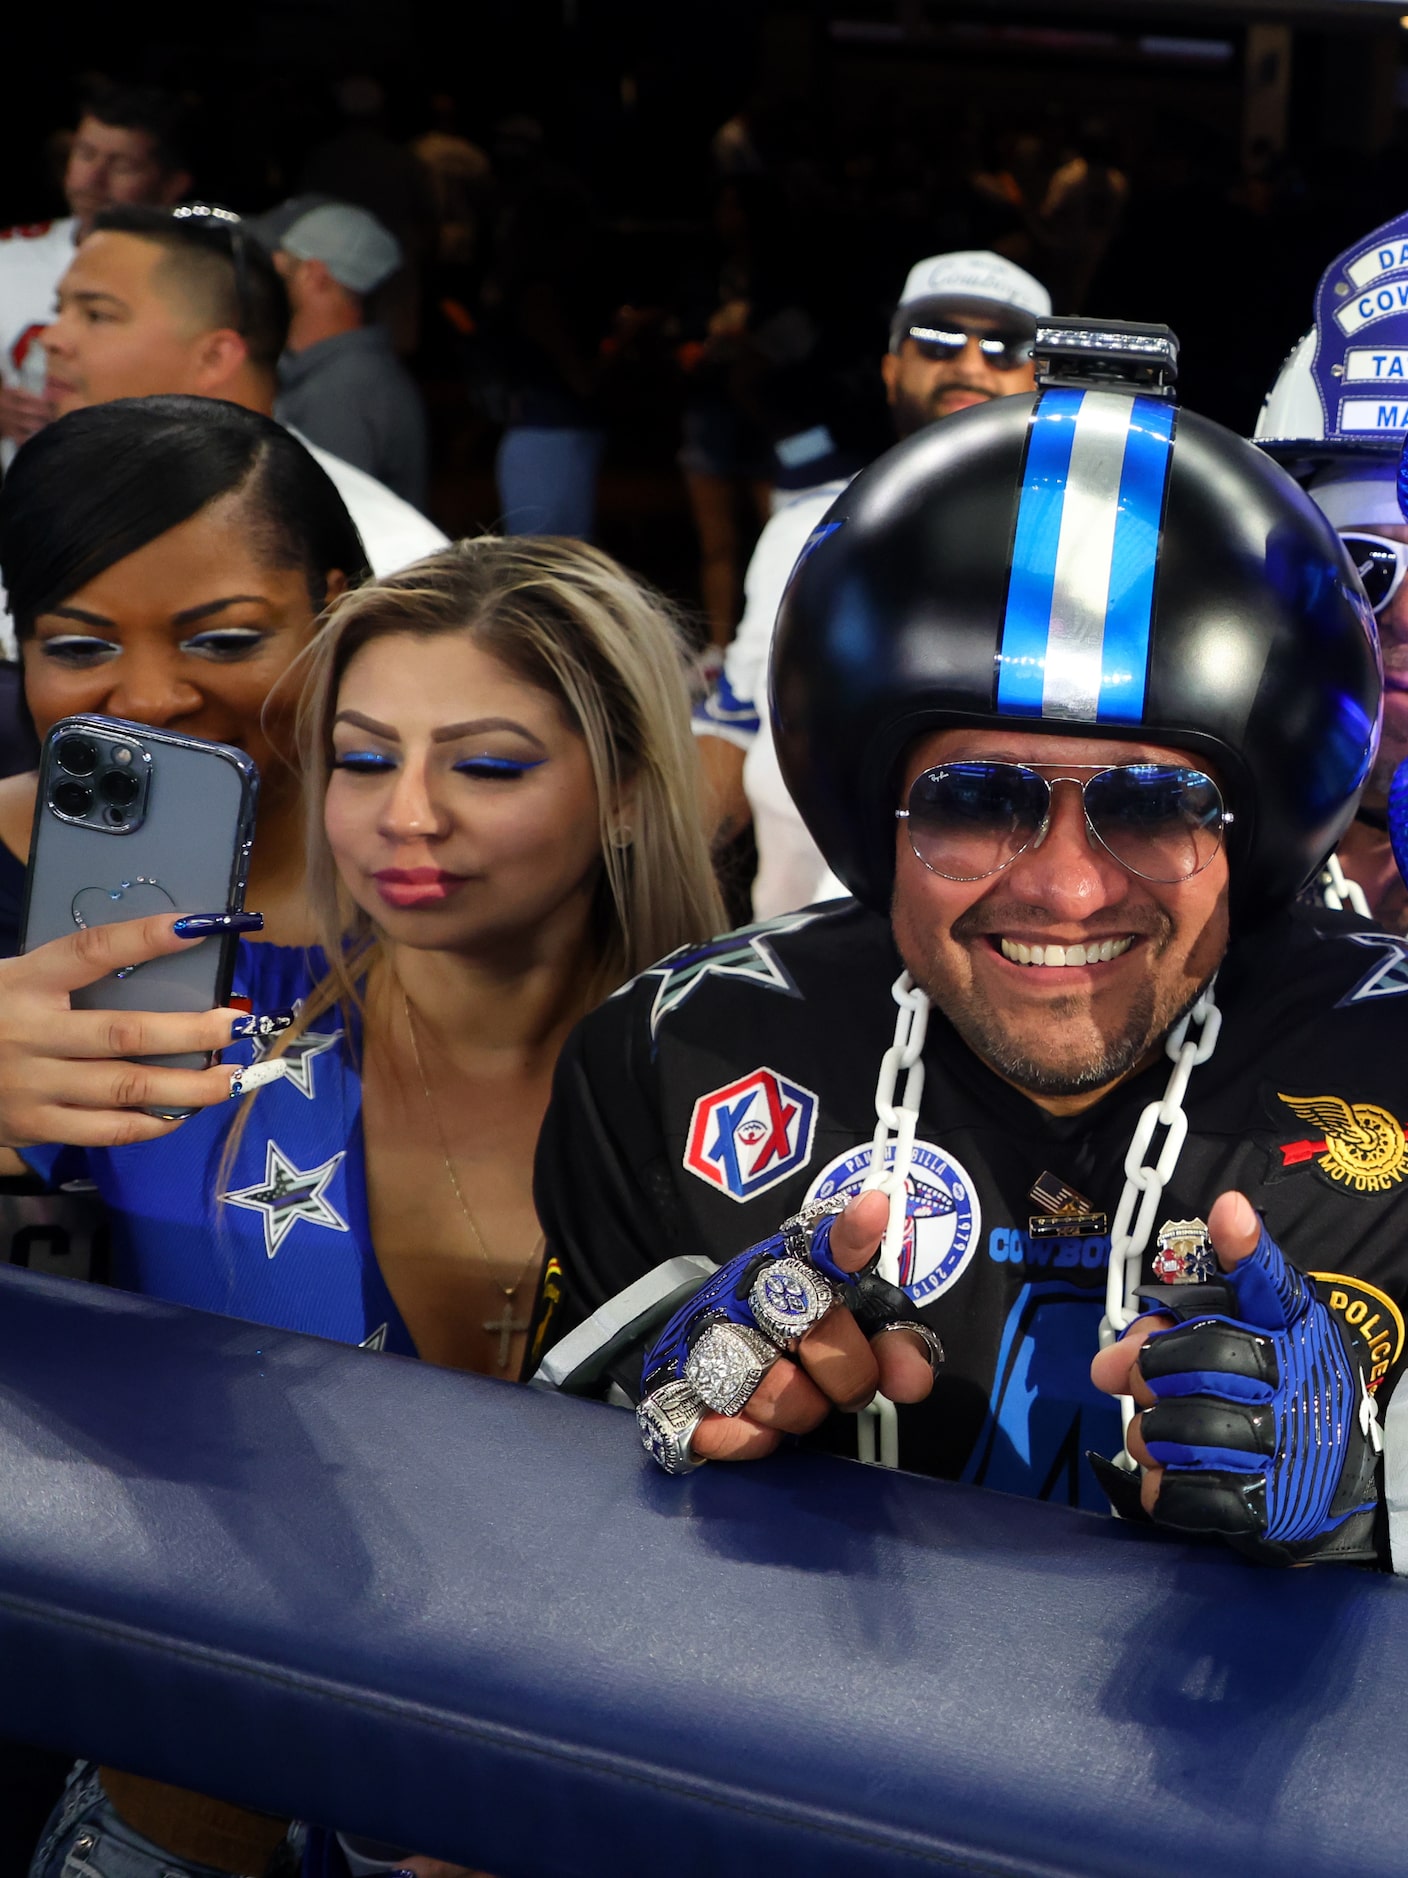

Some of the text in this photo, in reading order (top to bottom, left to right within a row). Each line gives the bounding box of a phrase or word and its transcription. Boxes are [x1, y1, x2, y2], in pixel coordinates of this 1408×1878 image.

[956, 1212, 972, 1252] 1979
[988, 1226, 1111, 1269] COWBO
[912, 1266, 948, 1299] 2019
[1329, 1290, 1392, 1382] POLICE
